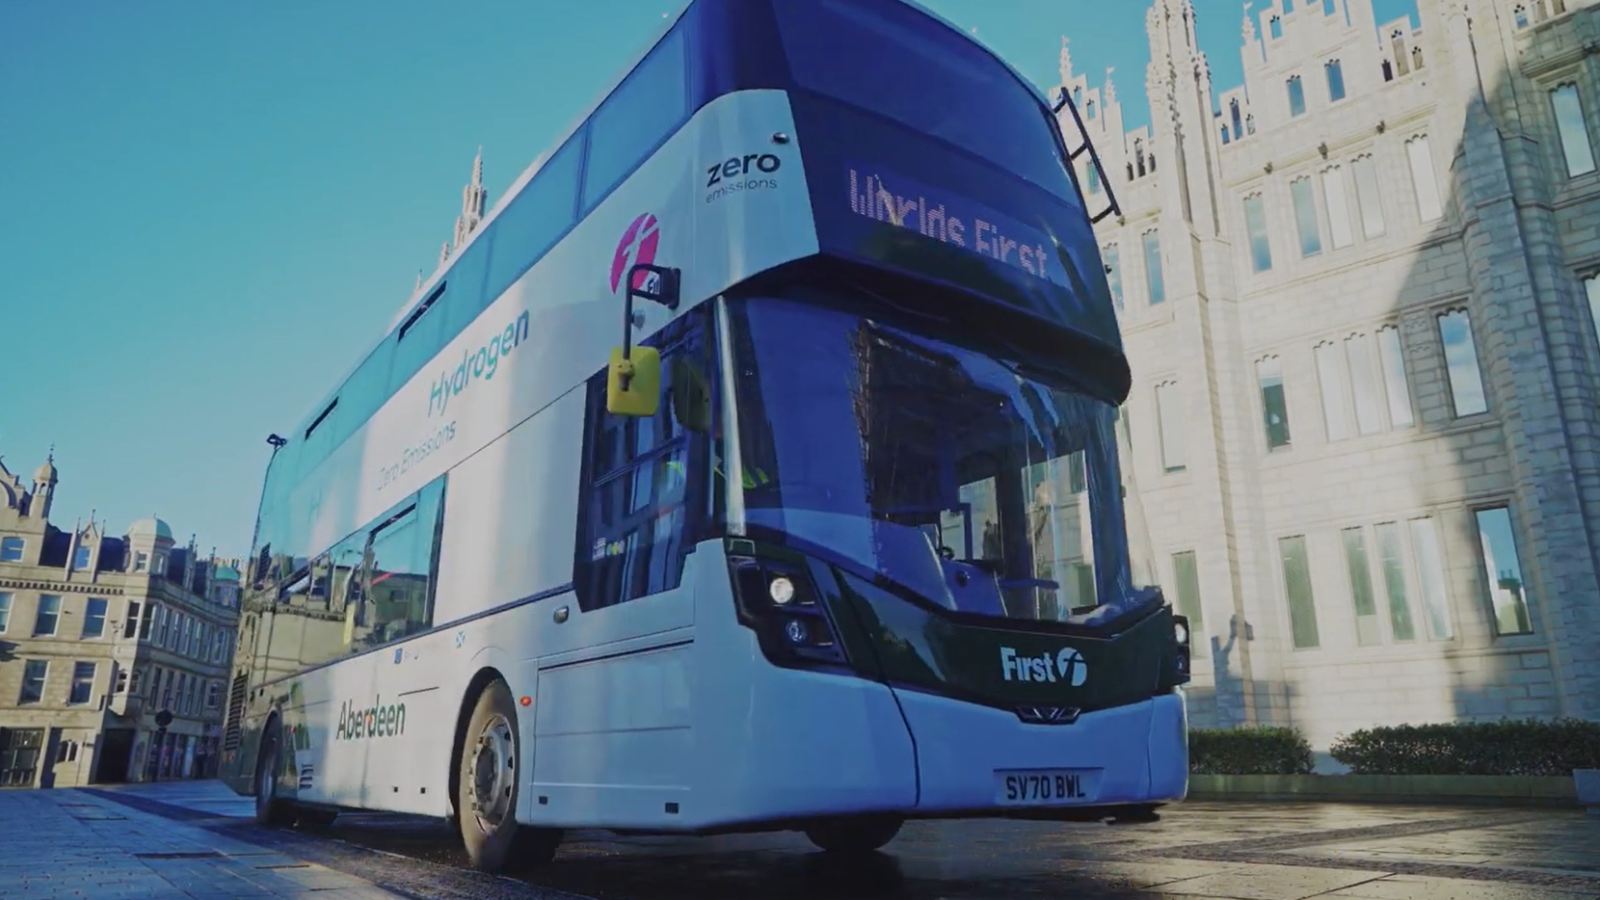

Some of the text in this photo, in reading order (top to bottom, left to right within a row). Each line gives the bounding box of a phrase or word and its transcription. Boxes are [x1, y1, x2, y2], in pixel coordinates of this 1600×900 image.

[706, 153, 781, 188] zero
[706, 179, 778, 204] emissions
[976, 219, 1047, 279] First
[428, 310, 529, 418] Hydrogen
[376, 420, 457, 492] Zero Emissions
[1000, 647, 1056, 683] First
[336, 693, 406, 740] Aberdeen
[1006, 775, 1086, 800] SV70 BWL
